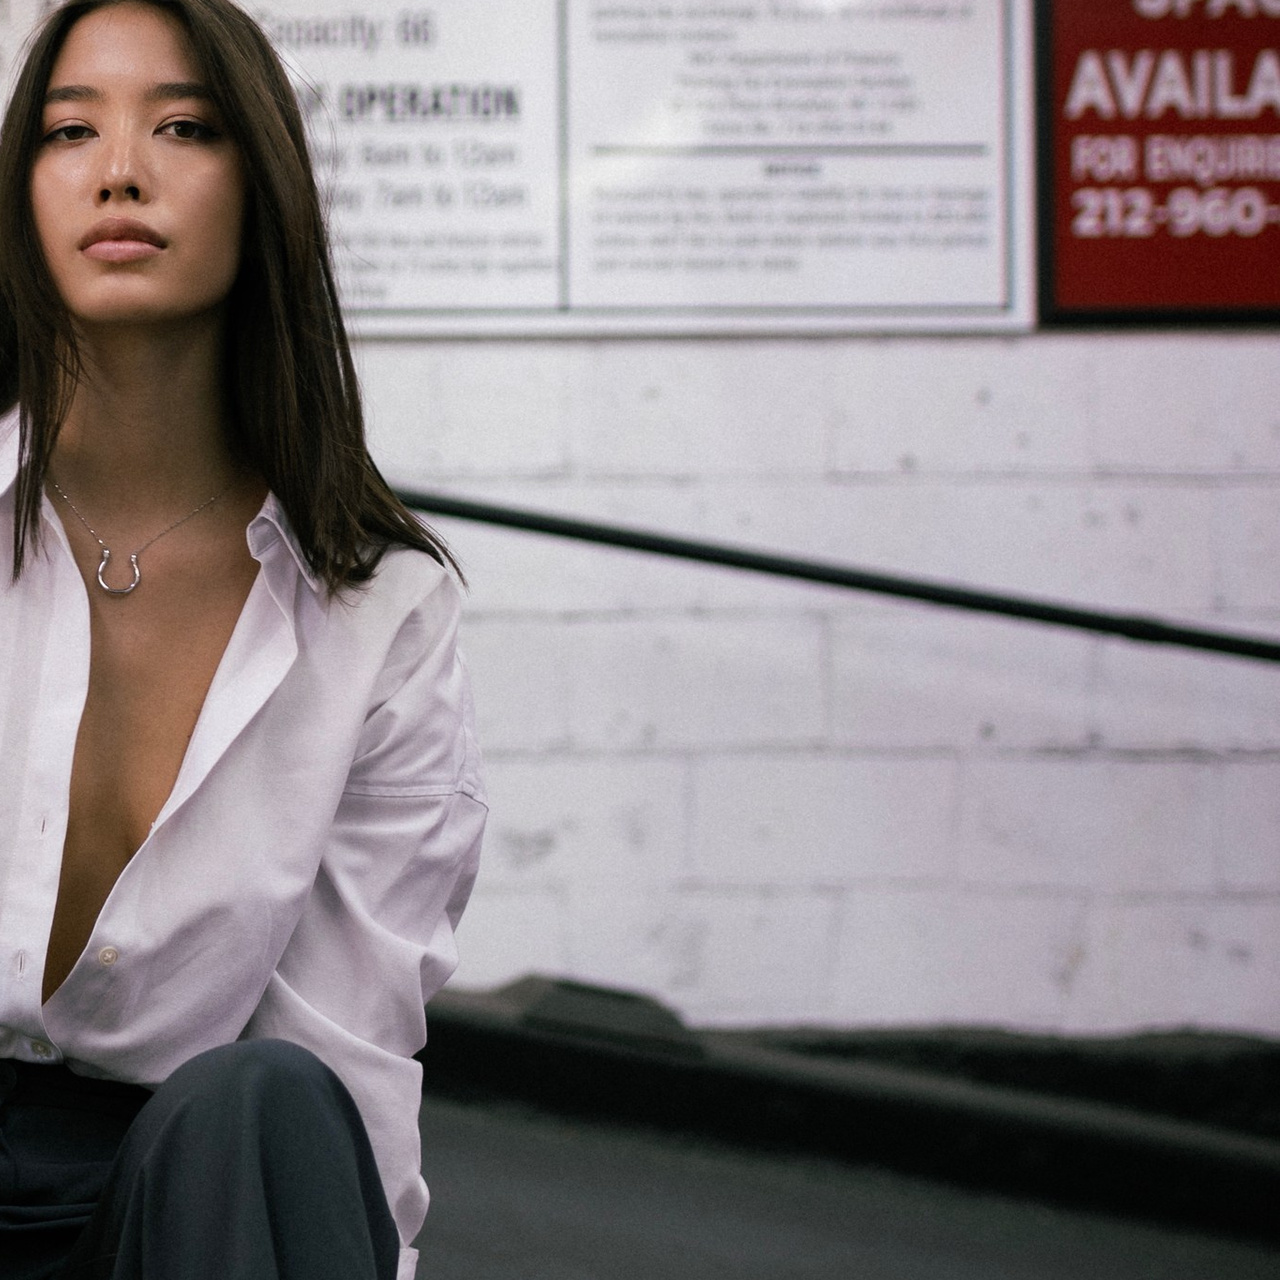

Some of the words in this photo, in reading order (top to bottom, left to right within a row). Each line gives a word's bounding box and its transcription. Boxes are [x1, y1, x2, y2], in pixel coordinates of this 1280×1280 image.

[340, 84, 523, 122] OPERATION
[1066, 51, 1280, 118] AVAILA
[1072, 137, 1134, 179] FOR
